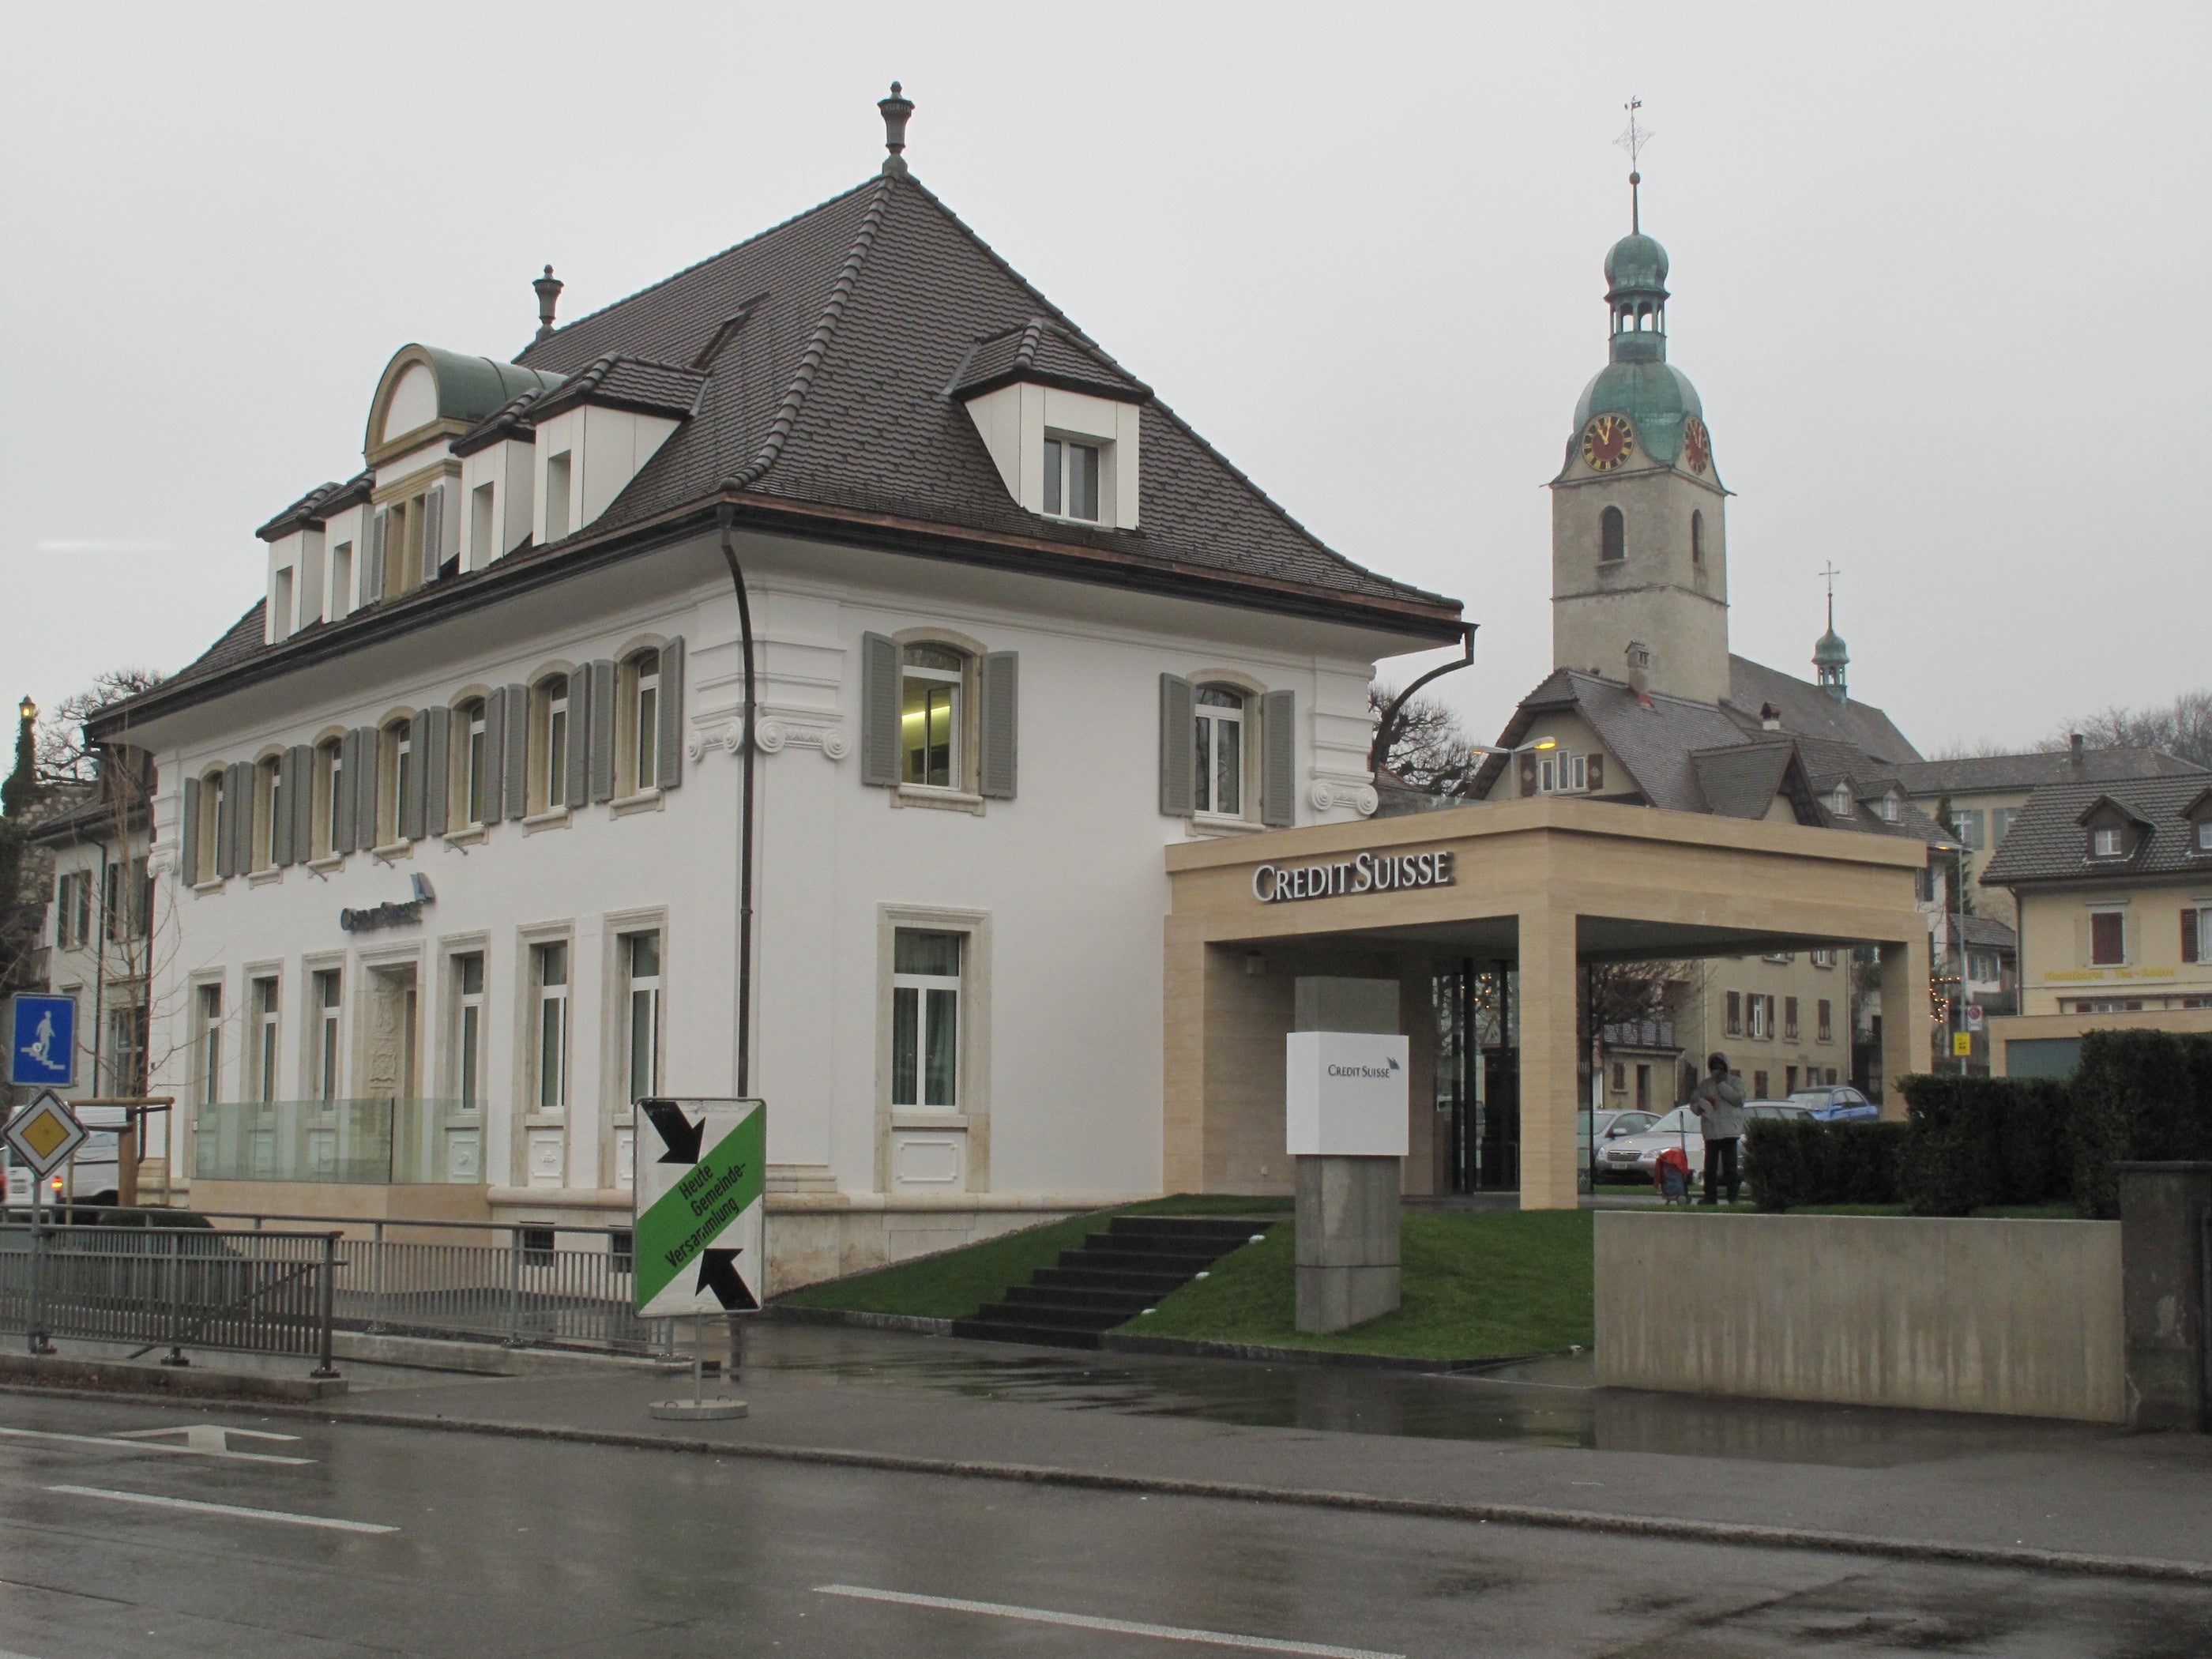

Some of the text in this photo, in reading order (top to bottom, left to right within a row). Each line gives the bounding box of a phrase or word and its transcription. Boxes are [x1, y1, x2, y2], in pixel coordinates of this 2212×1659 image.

[1255, 852, 1449, 901] CREDIT SUISSE
[1327, 1063, 1390, 1078] CREDIT SUISSE
[679, 1164, 713, 1200] Heute
[691, 1163, 746, 1217] Gemeinde-
[665, 1197, 739, 1267] Versammlung
